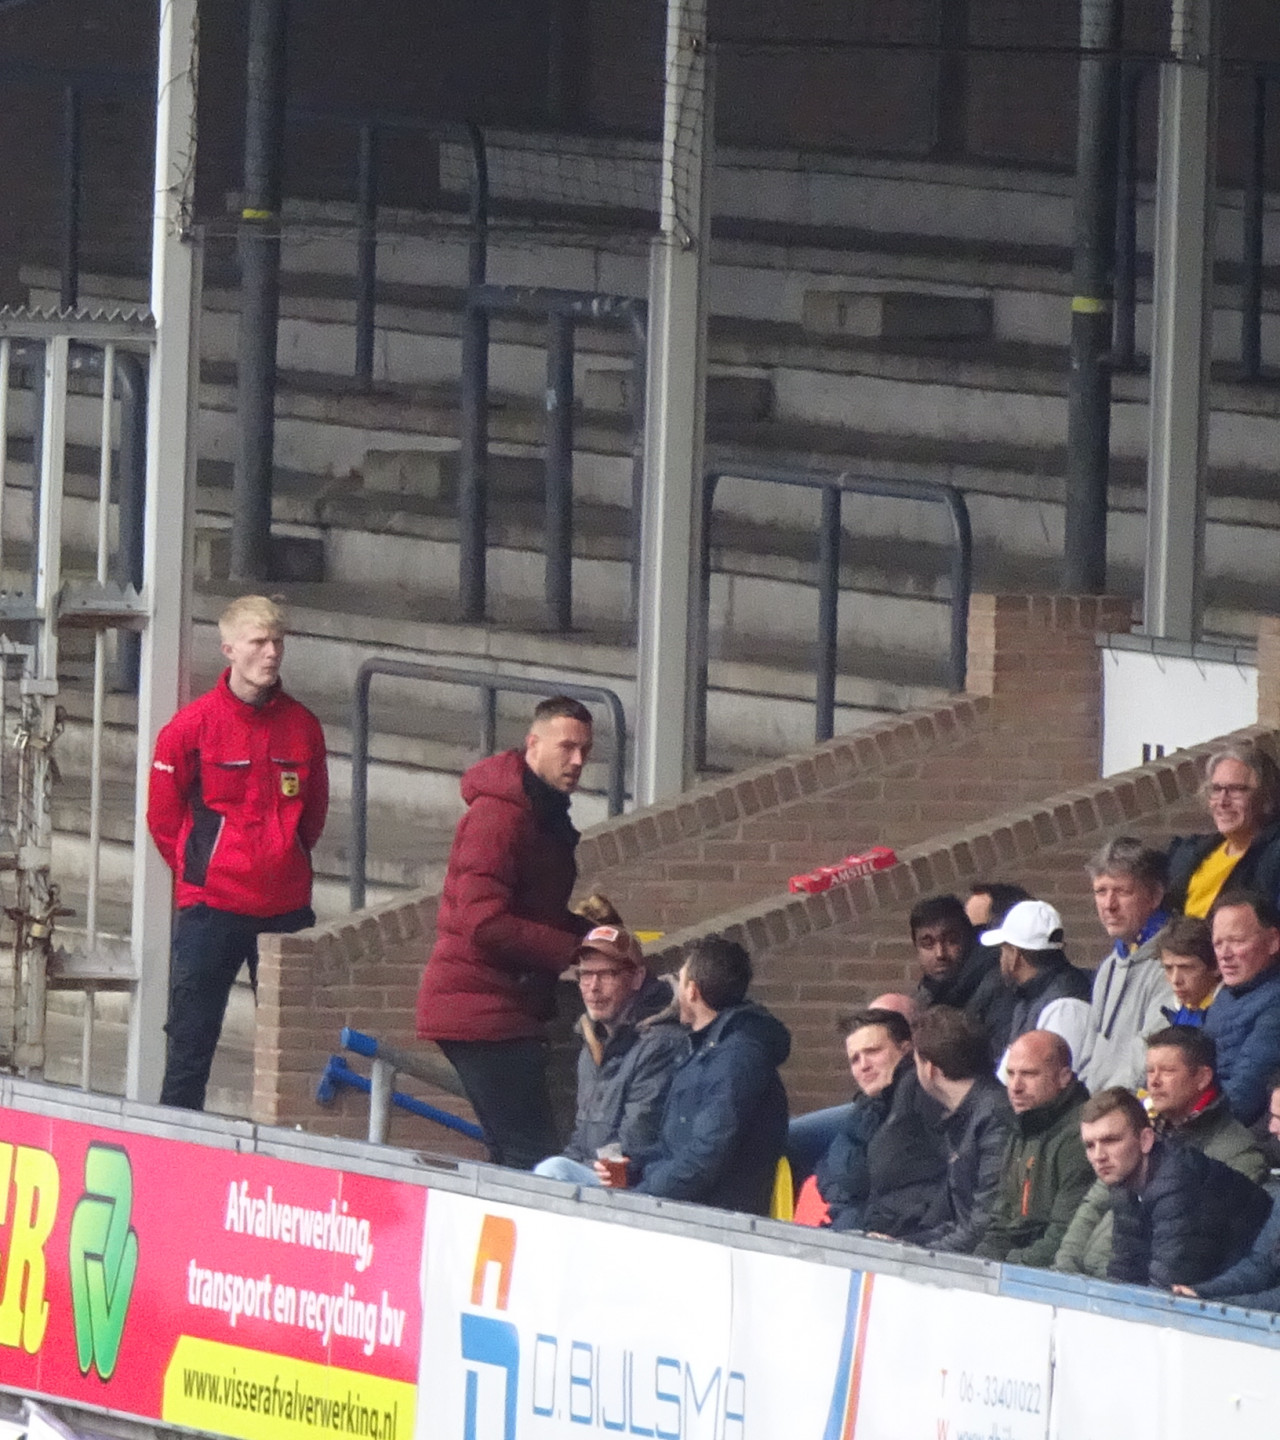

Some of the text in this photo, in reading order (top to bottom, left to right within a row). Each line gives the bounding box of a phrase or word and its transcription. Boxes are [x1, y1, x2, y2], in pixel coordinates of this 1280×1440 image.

[225, 1179, 374, 1273] Afvalverwerking,
[188, 1258, 406, 1356] transport en recycling bv
[183, 1367, 398, 1440] www.visserafvalverwerking.nl
